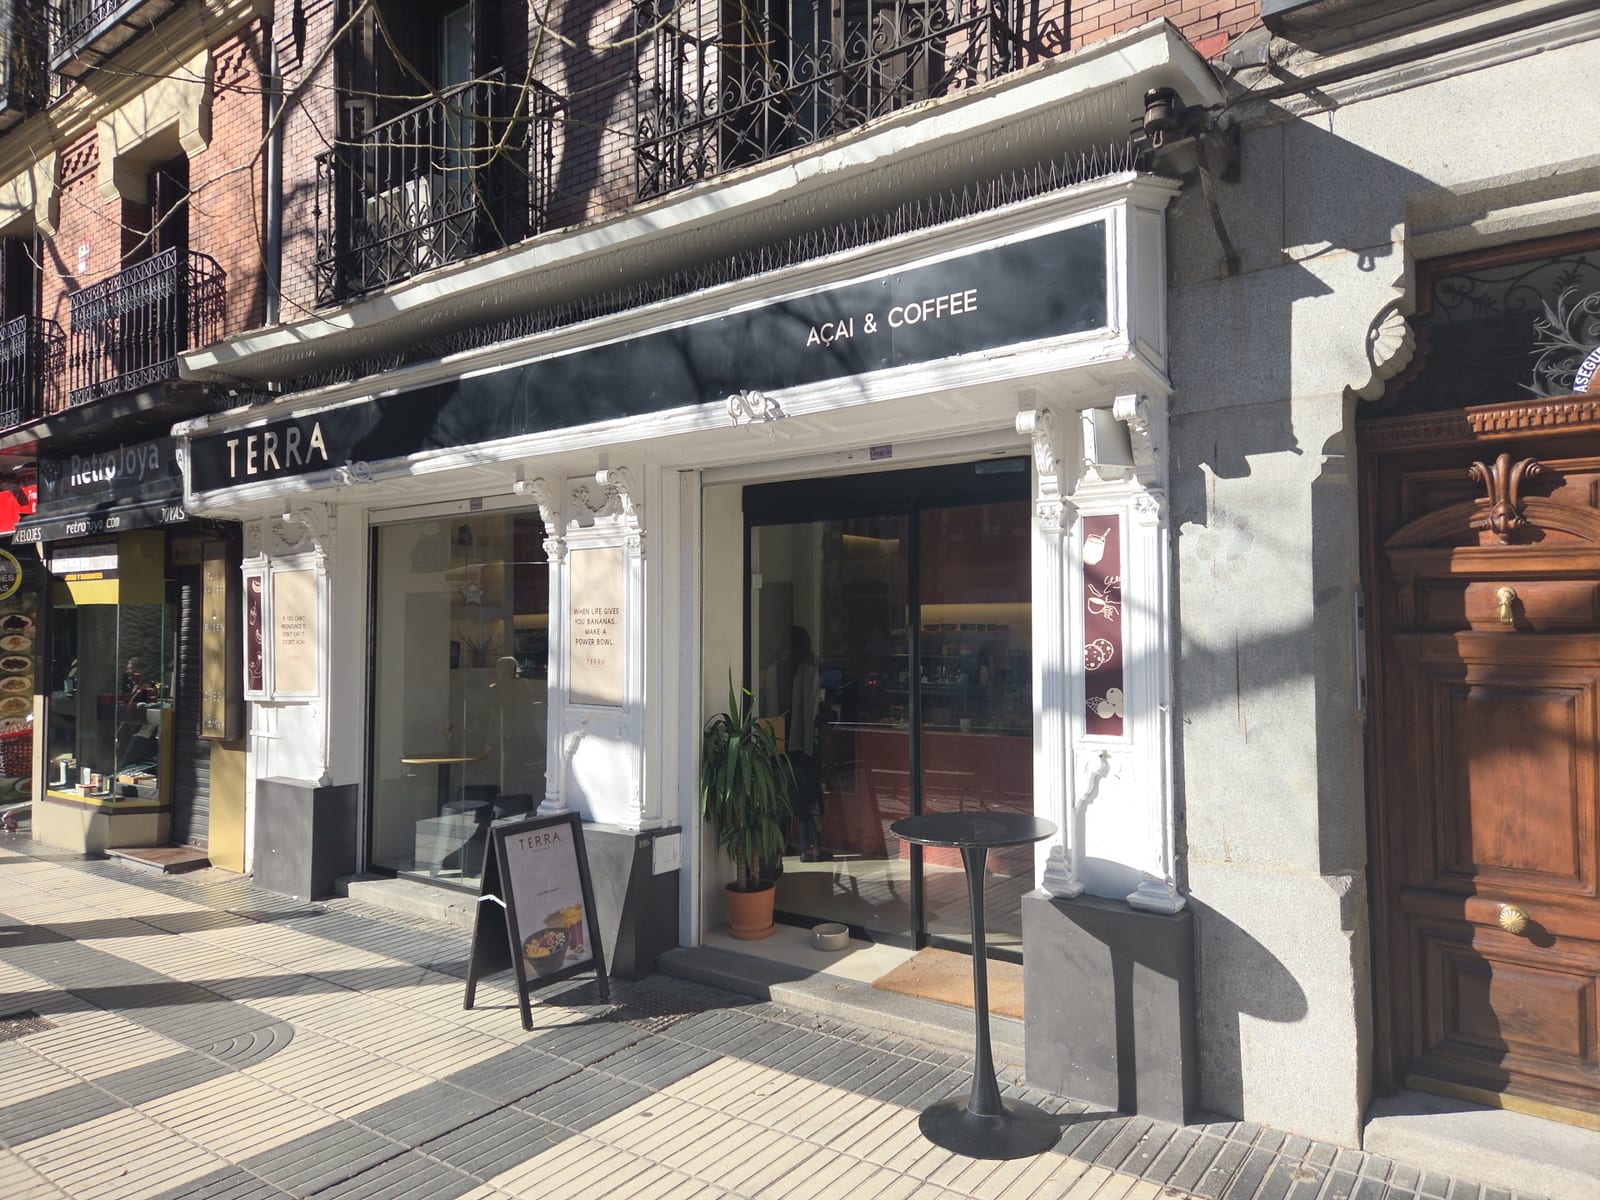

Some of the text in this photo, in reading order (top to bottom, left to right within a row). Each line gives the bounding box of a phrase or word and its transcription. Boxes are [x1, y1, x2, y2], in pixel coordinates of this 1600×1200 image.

[806, 288, 978, 347] AÇAI & COFFEE
[1573, 346, 1600, 393] ASEGU
[71, 443, 159, 487] RetroJoya
[226, 421, 329, 478] TERRA
[591, 607, 602, 615] LIFE
[603, 607, 620, 615] GIVES
[575, 638, 595, 646] POWER
[518, 831, 561, 850] TERRA
